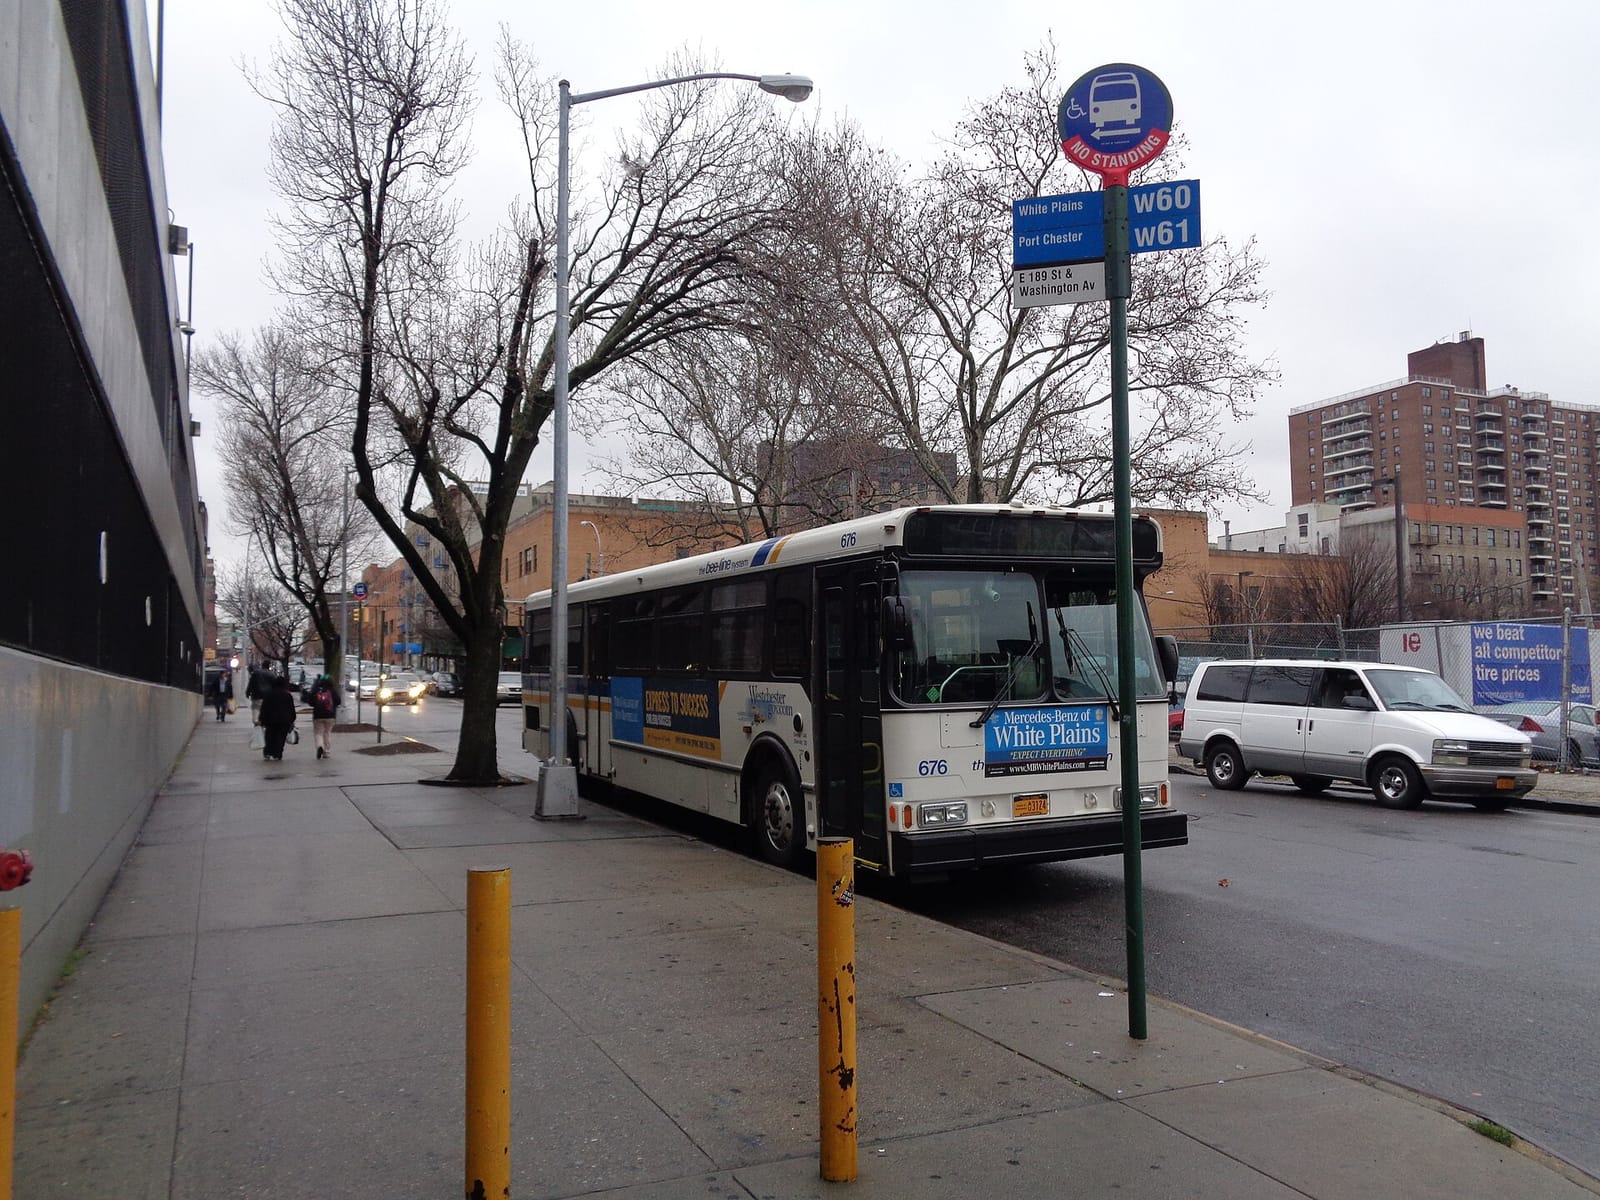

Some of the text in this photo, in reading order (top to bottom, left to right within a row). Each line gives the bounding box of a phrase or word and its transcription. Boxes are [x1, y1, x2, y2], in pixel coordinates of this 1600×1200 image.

[1070, 134, 1161, 168] NO STANDING
[1133, 185, 1191, 214] W60
[1018, 200, 1084, 217] White Plains
[1018, 231, 1083, 247] Port Chester
[1134, 218, 1188, 248] W61
[1019, 268, 1073, 283] E 189 St &
[1019, 280, 1095, 297] Washington Av
[840, 532, 857, 548] 676
[1473, 624, 1525, 641] we beat
[1475, 642, 1491, 659] all
[1475, 664, 1541, 685] tire prices
[748, 685, 787, 704] Westchester
[645, 690, 671, 713] EXPRESS
[671, 692, 680, 715] TO
[680, 692, 709, 719] SUCCESS
[1004, 710, 1078, 725] Mercedes-Benz
[1081, 709, 1091, 721] of
[993, 722, 1101, 749] White Plains
[918, 759, 948, 776] 676
